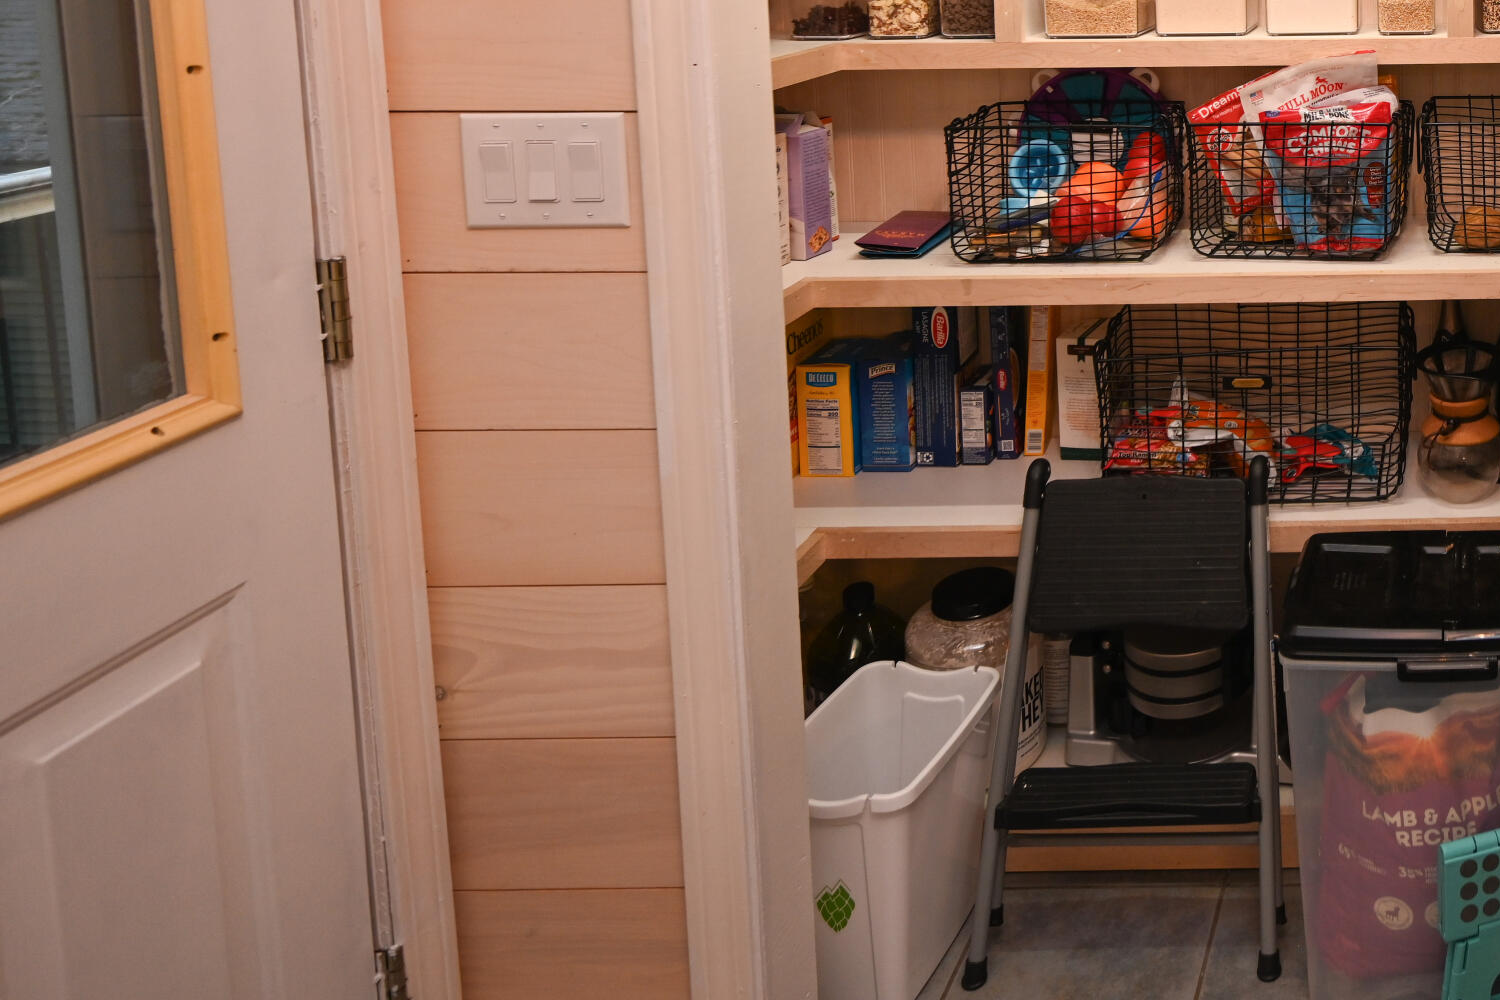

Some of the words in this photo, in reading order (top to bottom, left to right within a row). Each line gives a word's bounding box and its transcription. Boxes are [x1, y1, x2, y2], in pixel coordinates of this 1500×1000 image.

[1198, 91, 1240, 119] Dream
[1278, 93, 1309, 111] FULL
[1310, 83, 1345, 100] MOON
[1287, 126, 1372, 153] COMFORT
[1303, 140, 1357, 158] CHEWS
[921, 311, 929, 344] LASAGNE
[936, 315, 945, 345] Barilla
[870, 364, 894, 376] Prince
[1132, 450, 1157, 458] Ramn
[1021, 688, 1044, 733] HEY
[1362, 800, 1418, 827] LAMB
[1423, 808, 1438, 825] &
[1395, 821, 1477, 848] RECIPE
